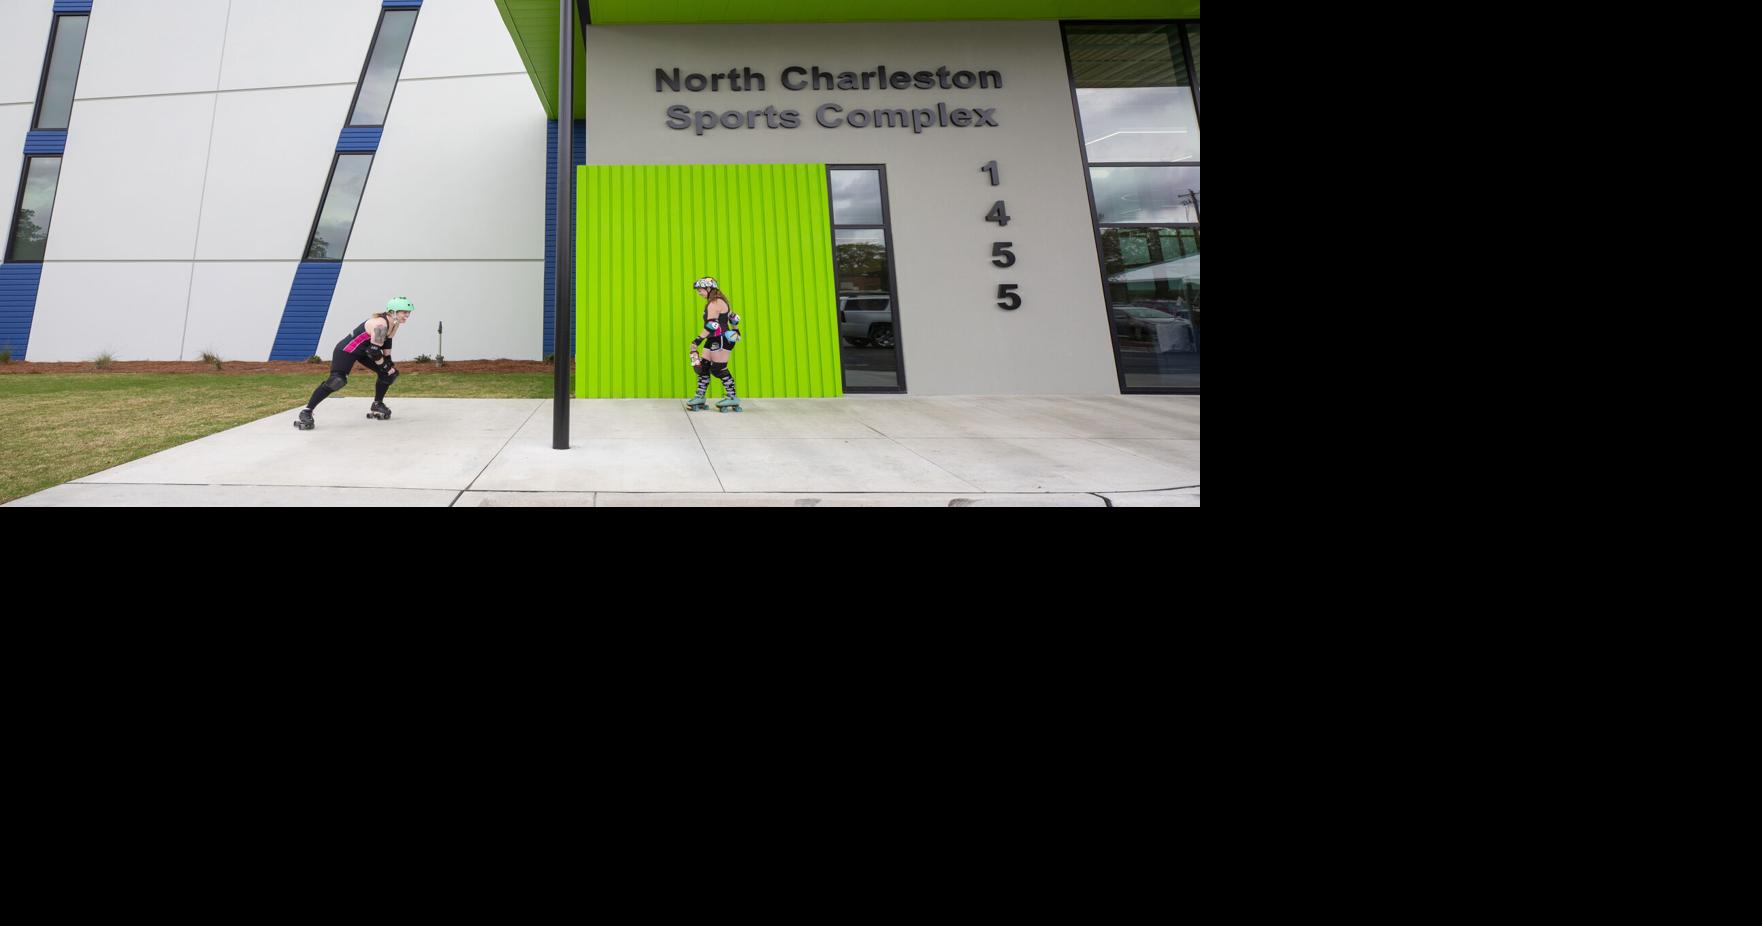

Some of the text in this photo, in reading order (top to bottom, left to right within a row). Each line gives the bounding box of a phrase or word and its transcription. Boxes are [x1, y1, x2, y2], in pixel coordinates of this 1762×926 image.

[655, 65, 1003, 92] North Charleston
[666, 102, 998, 135] Sports Complex
